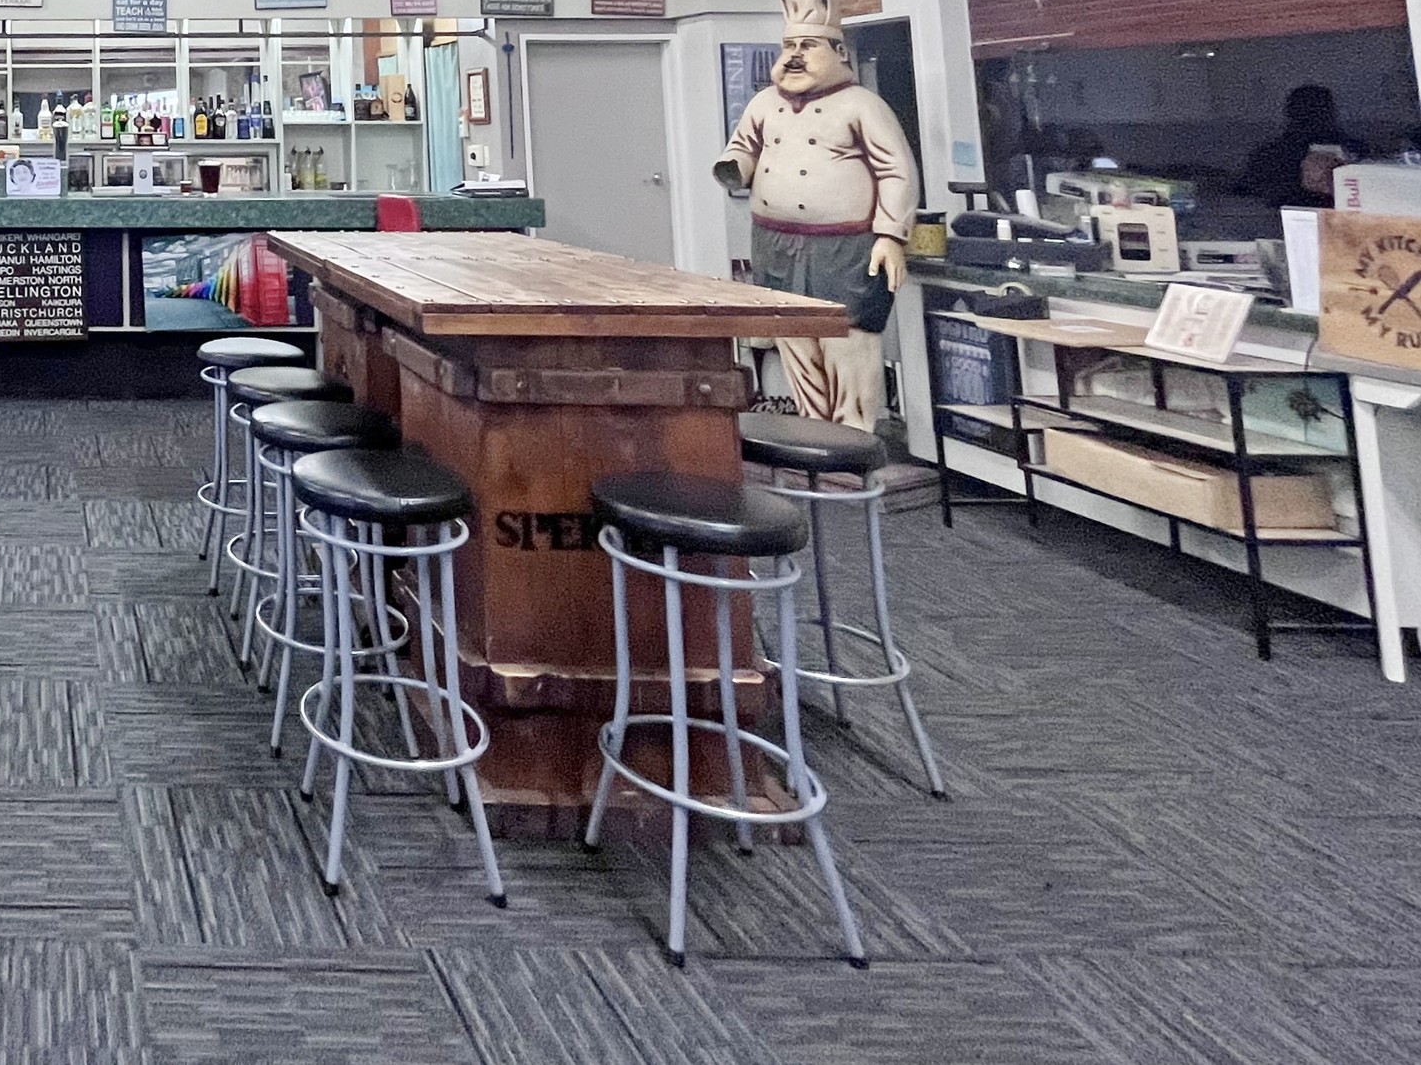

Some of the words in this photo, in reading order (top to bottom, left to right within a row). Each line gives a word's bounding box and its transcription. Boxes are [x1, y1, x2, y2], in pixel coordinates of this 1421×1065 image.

[116, 6, 144, 16] TEACH
[1344, 178, 1362, 208] Bull
[27, 233, 81, 242] WHANGAREI
[30, 254, 82, 264] HAMILTON
[32, 266, 82, 274] HASTINGS
[48, 276, 82, 284] NORTH
[24, 318, 83, 327] QUEENSTOWN
[24, 328, 84, 336] INVERCARGILL
